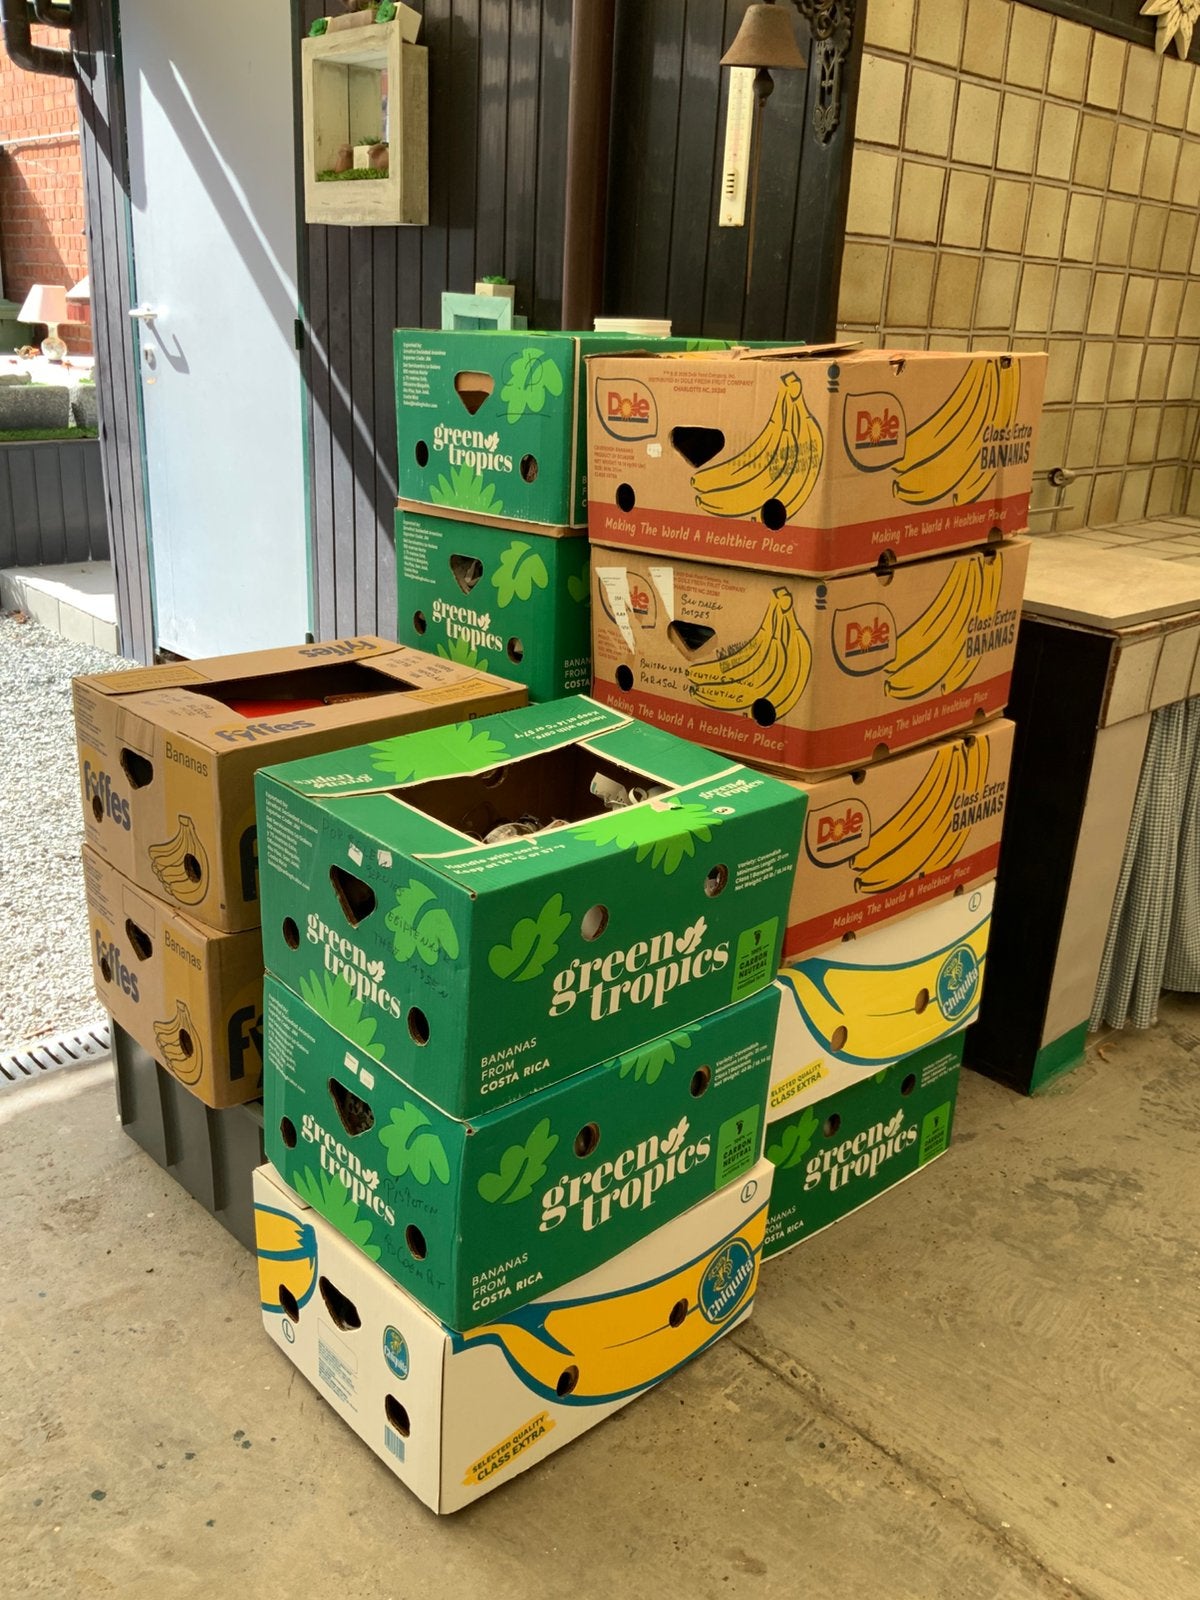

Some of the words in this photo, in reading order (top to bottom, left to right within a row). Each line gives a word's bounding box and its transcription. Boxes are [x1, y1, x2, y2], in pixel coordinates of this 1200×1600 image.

[607, 391, 650, 418] Dole
[433, 422, 484, 451] green
[855, 408, 900, 444] Dole
[983, 426, 1011, 444] Class
[1013, 423, 1033, 440] Extra
[449, 443, 513, 476] tropics
[980, 441, 1031, 470] BANANAS
[605, 517, 636, 537] Making
[640, 522, 657, 537] The
[661, 526, 689, 541] World
[694, 532, 701, 542] A
[706, 531, 758, 550] Healthier
[871, 530, 900, 545] Making
[904, 524, 919, 538] The
[921, 519, 942, 535] World
[945, 518, 950, 529] A
[953, 512, 985, 528] Healthier
[432, 598, 479, 624] green
[993, 609, 1017, 627] Extra
[446, 618, 503, 651] tropics
[845, 617, 890, 651] Dole
[966, 624, 1016, 659] BANANAS
[564, 668, 587, 678] FROM
[564, 679, 590, 690] COSTA
[215, 720, 316, 742] fyffes
[556, 725, 577, 733] with
[577, 711, 599, 719] Keep
[607, 694, 634, 717] Making
[638, 705, 655, 720] The
[658, 710, 684, 726] World
[687, 718, 694, 729] A
[699, 720, 750, 743] Healthier
[864, 725, 893, 742] Making
[896, 719, 910, 733] The
[912, 712, 932, 727] World
[934, 708, 940, 718] A
[942, 697, 972, 715] Healthier
[166, 741, 208, 777] Bananas
[699, 783, 737, 799] green
[716, 780, 765, 798] tropics
[954, 791, 979, 810] Class
[982, 780, 1006, 800] Extra
[817, 808, 864, 845] Dole
[952, 794, 1004, 833] BANANAS
[444, 860, 486, 869] Handle
[487, 852, 514, 861] with
[832, 911, 864, 929] Making
[867, 902, 882, 915] The
[885, 891, 906, 909] World
[909, 886, 915, 897] A
[917, 875, 951, 895] Healthier
[165, 930, 202, 971] Bananas
[307, 913, 366, 972] green
[740, 950, 768, 969] CARBON
[324, 944, 400, 1019] tropics
[549, 931, 675, 1017] green
[589, 941, 730, 1021] tropics
[739, 959, 767, 978] NEUTRAL
[942, 967, 979, 1017] Chiquita
[480, 1038, 537, 1068] BANANAS
[480, 1073, 520, 1095] COSTA
[524, 1058, 550, 1079] RICA
[481, 1060, 515, 1081] FROM
[770, 1080, 797, 1099] ELECTED
[798, 1063, 821, 1082] QUALITY
[770, 1087, 796, 1108] CLASS
[796, 1072, 822, 1091] EXTRA
[301, 1114, 362, 1175] green
[723, 1137, 752, 1159] CARBON
[723, 1146, 751, 1167] NEUTRAL
[803, 1121, 884, 1191] green
[829, 1124, 918, 1192] tropics
[320, 1144, 396, 1226] tropics
[539, 1135, 659, 1232] green
[582, 1134, 711, 1231] tropics
[764, 1230, 785, 1244] OSTA
[787, 1220, 804, 1234] RICA
[767, 1205, 796, 1225] ANANAS
[472, 1253, 528, 1287] BANANAS
[472, 1275, 507, 1299] FROM
[472, 1287, 512, 1312] COSTA
[516, 1271, 543, 1292] RICA
[707, 1259, 754, 1322] Chiquita
[472, 1442, 511, 1474] SELECTED
[512, 1415, 545, 1443] QUALITY
[477, 1451, 511, 1482] CLASS
[512, 1426, 546, 1457] EXTRA
